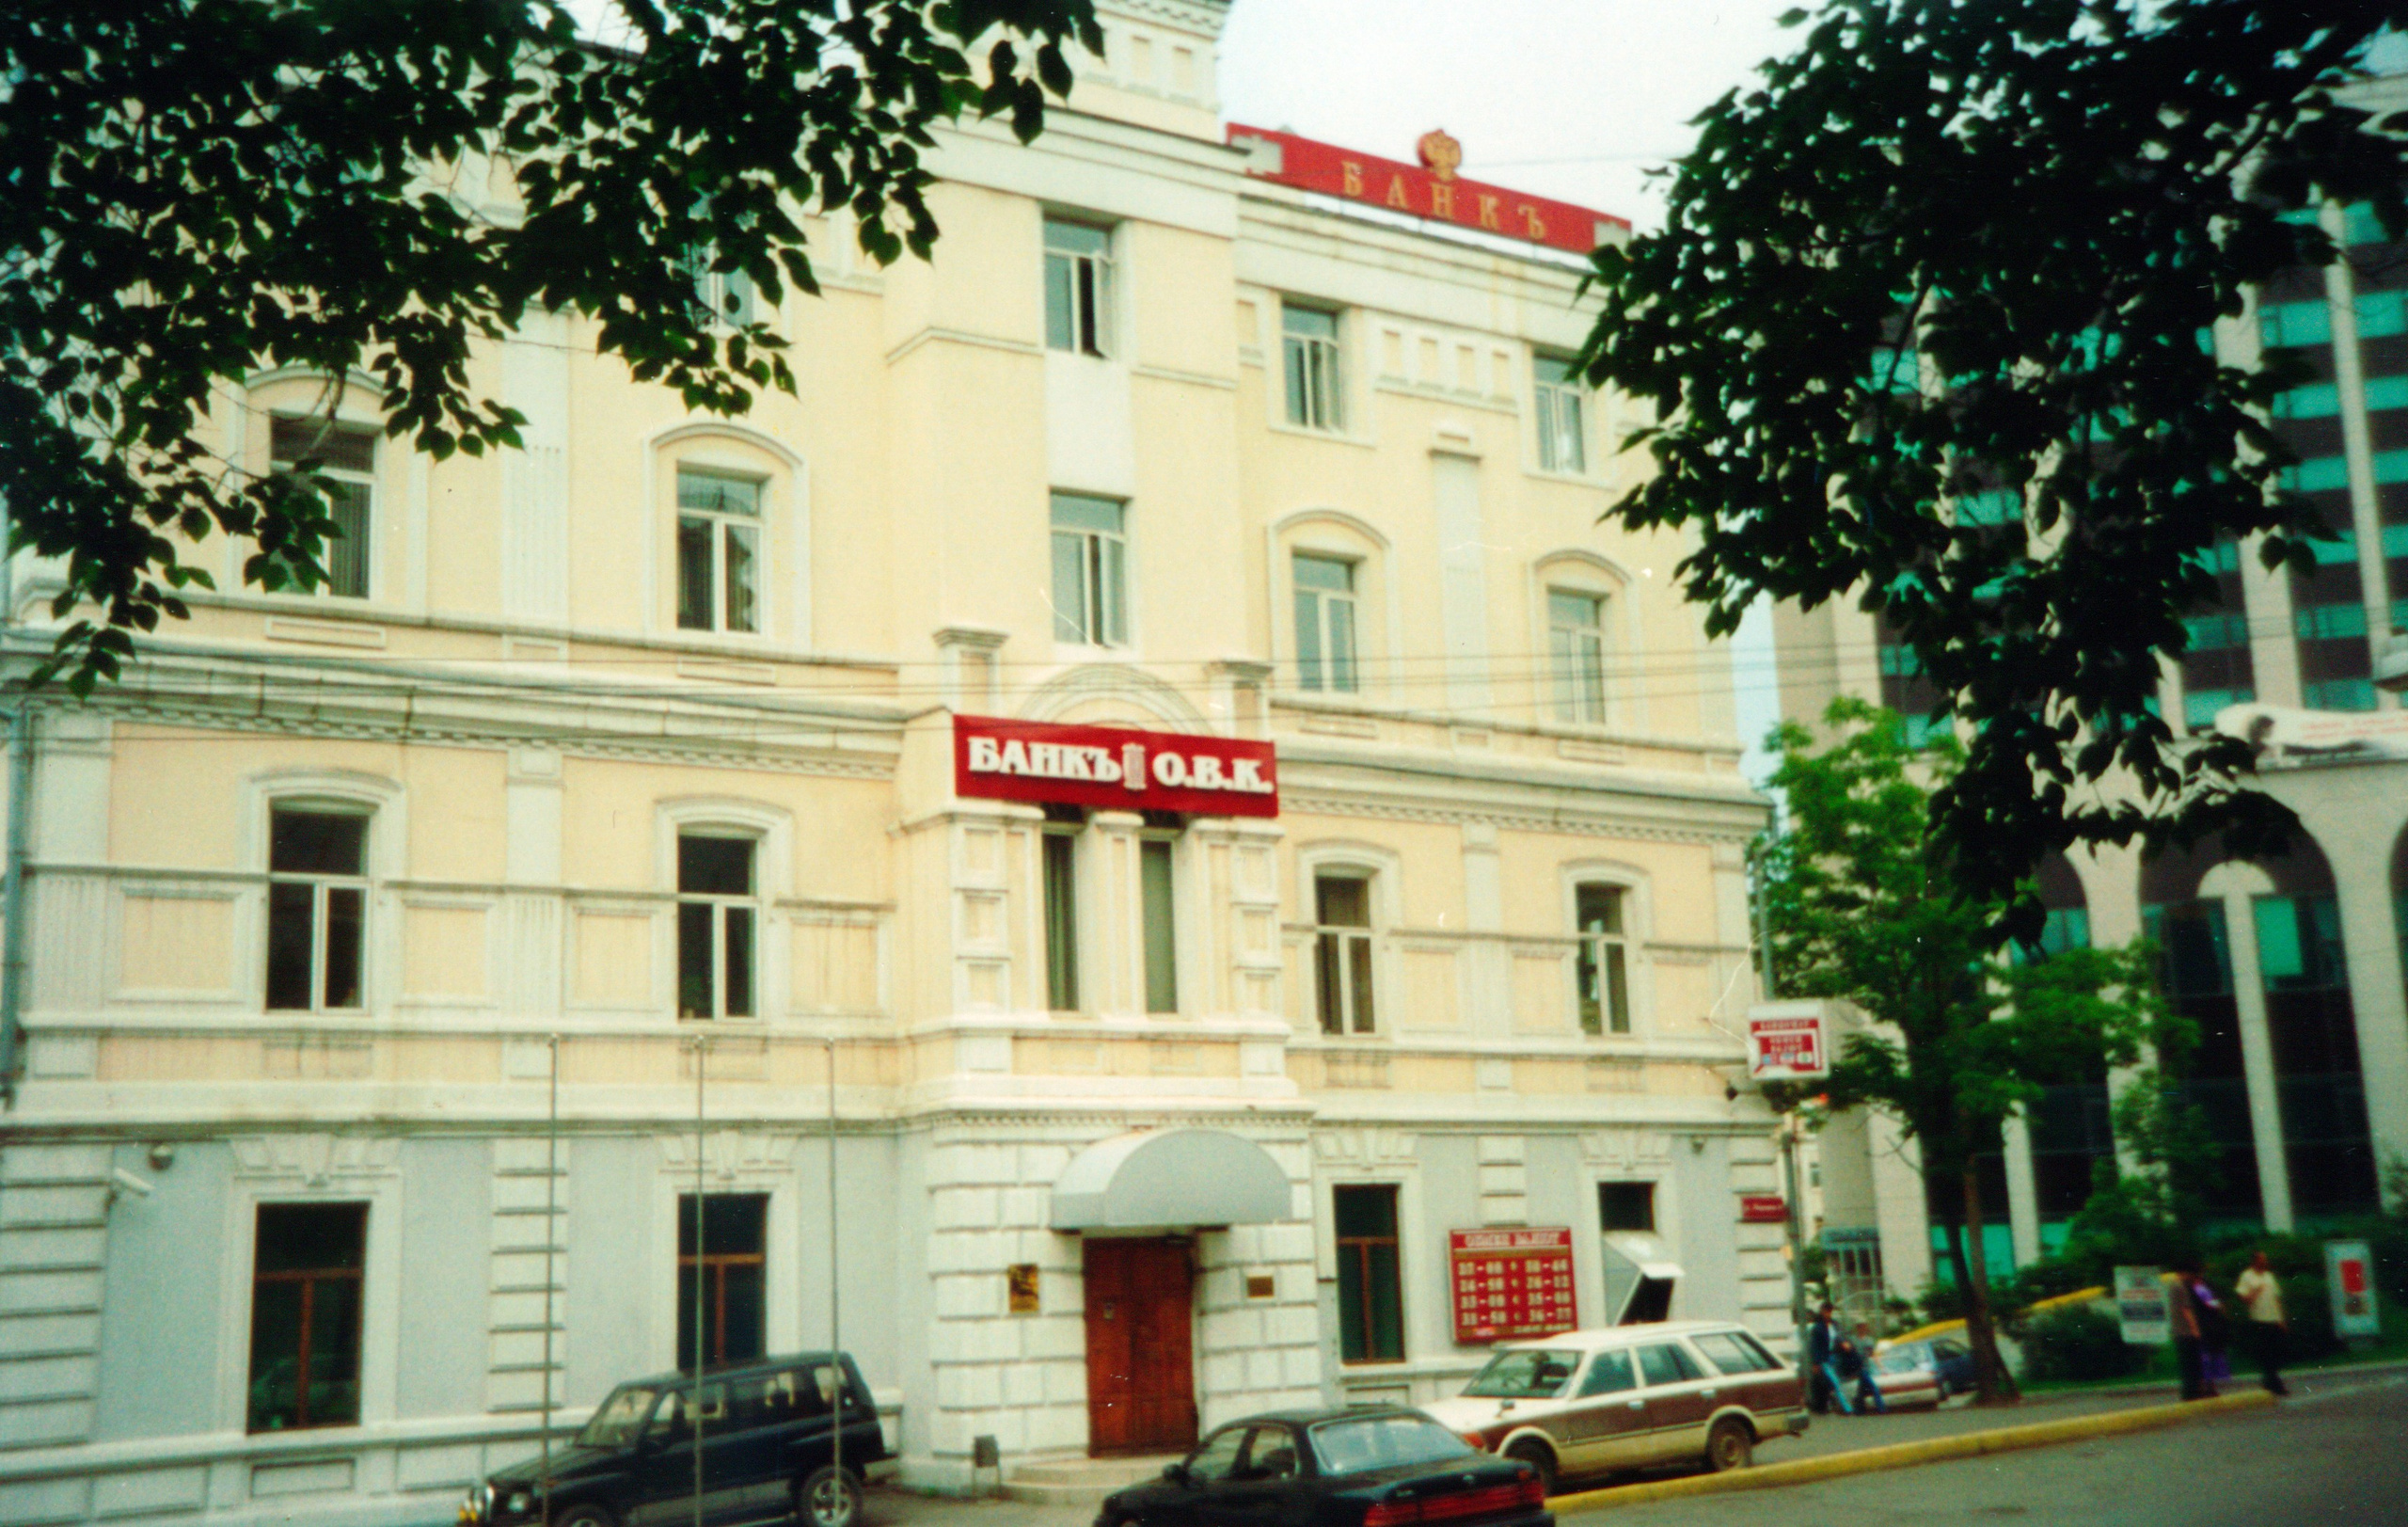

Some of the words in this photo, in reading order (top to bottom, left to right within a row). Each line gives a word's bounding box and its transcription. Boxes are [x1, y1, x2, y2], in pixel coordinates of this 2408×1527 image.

[1342, 161, 1545, 240] БАНКЪ
[967, 737, 1122, 782] БАНКЪ
[1153, 753, 1274, 794] О.В.К.
